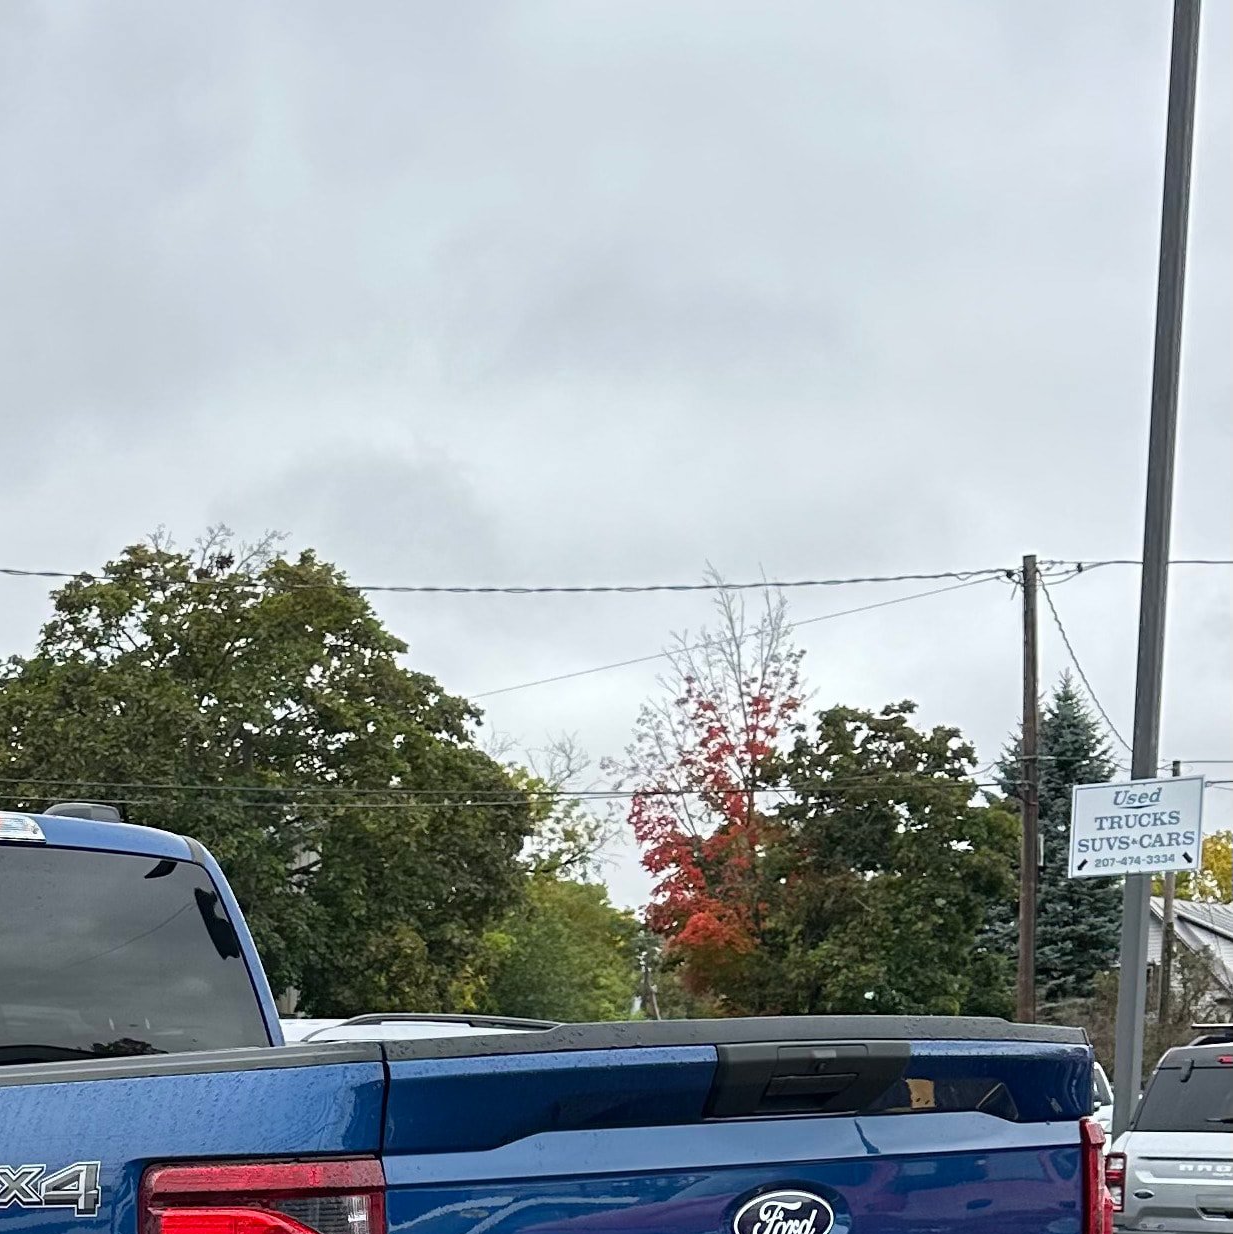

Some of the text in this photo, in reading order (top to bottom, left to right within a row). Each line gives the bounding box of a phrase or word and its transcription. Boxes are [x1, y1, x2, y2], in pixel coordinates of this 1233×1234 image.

[1113, 787, 1162, 806] Used
[1094, 810, 1180, 831] TRUCKS
[1094, 854, 1175, 868] 207-474-3334
